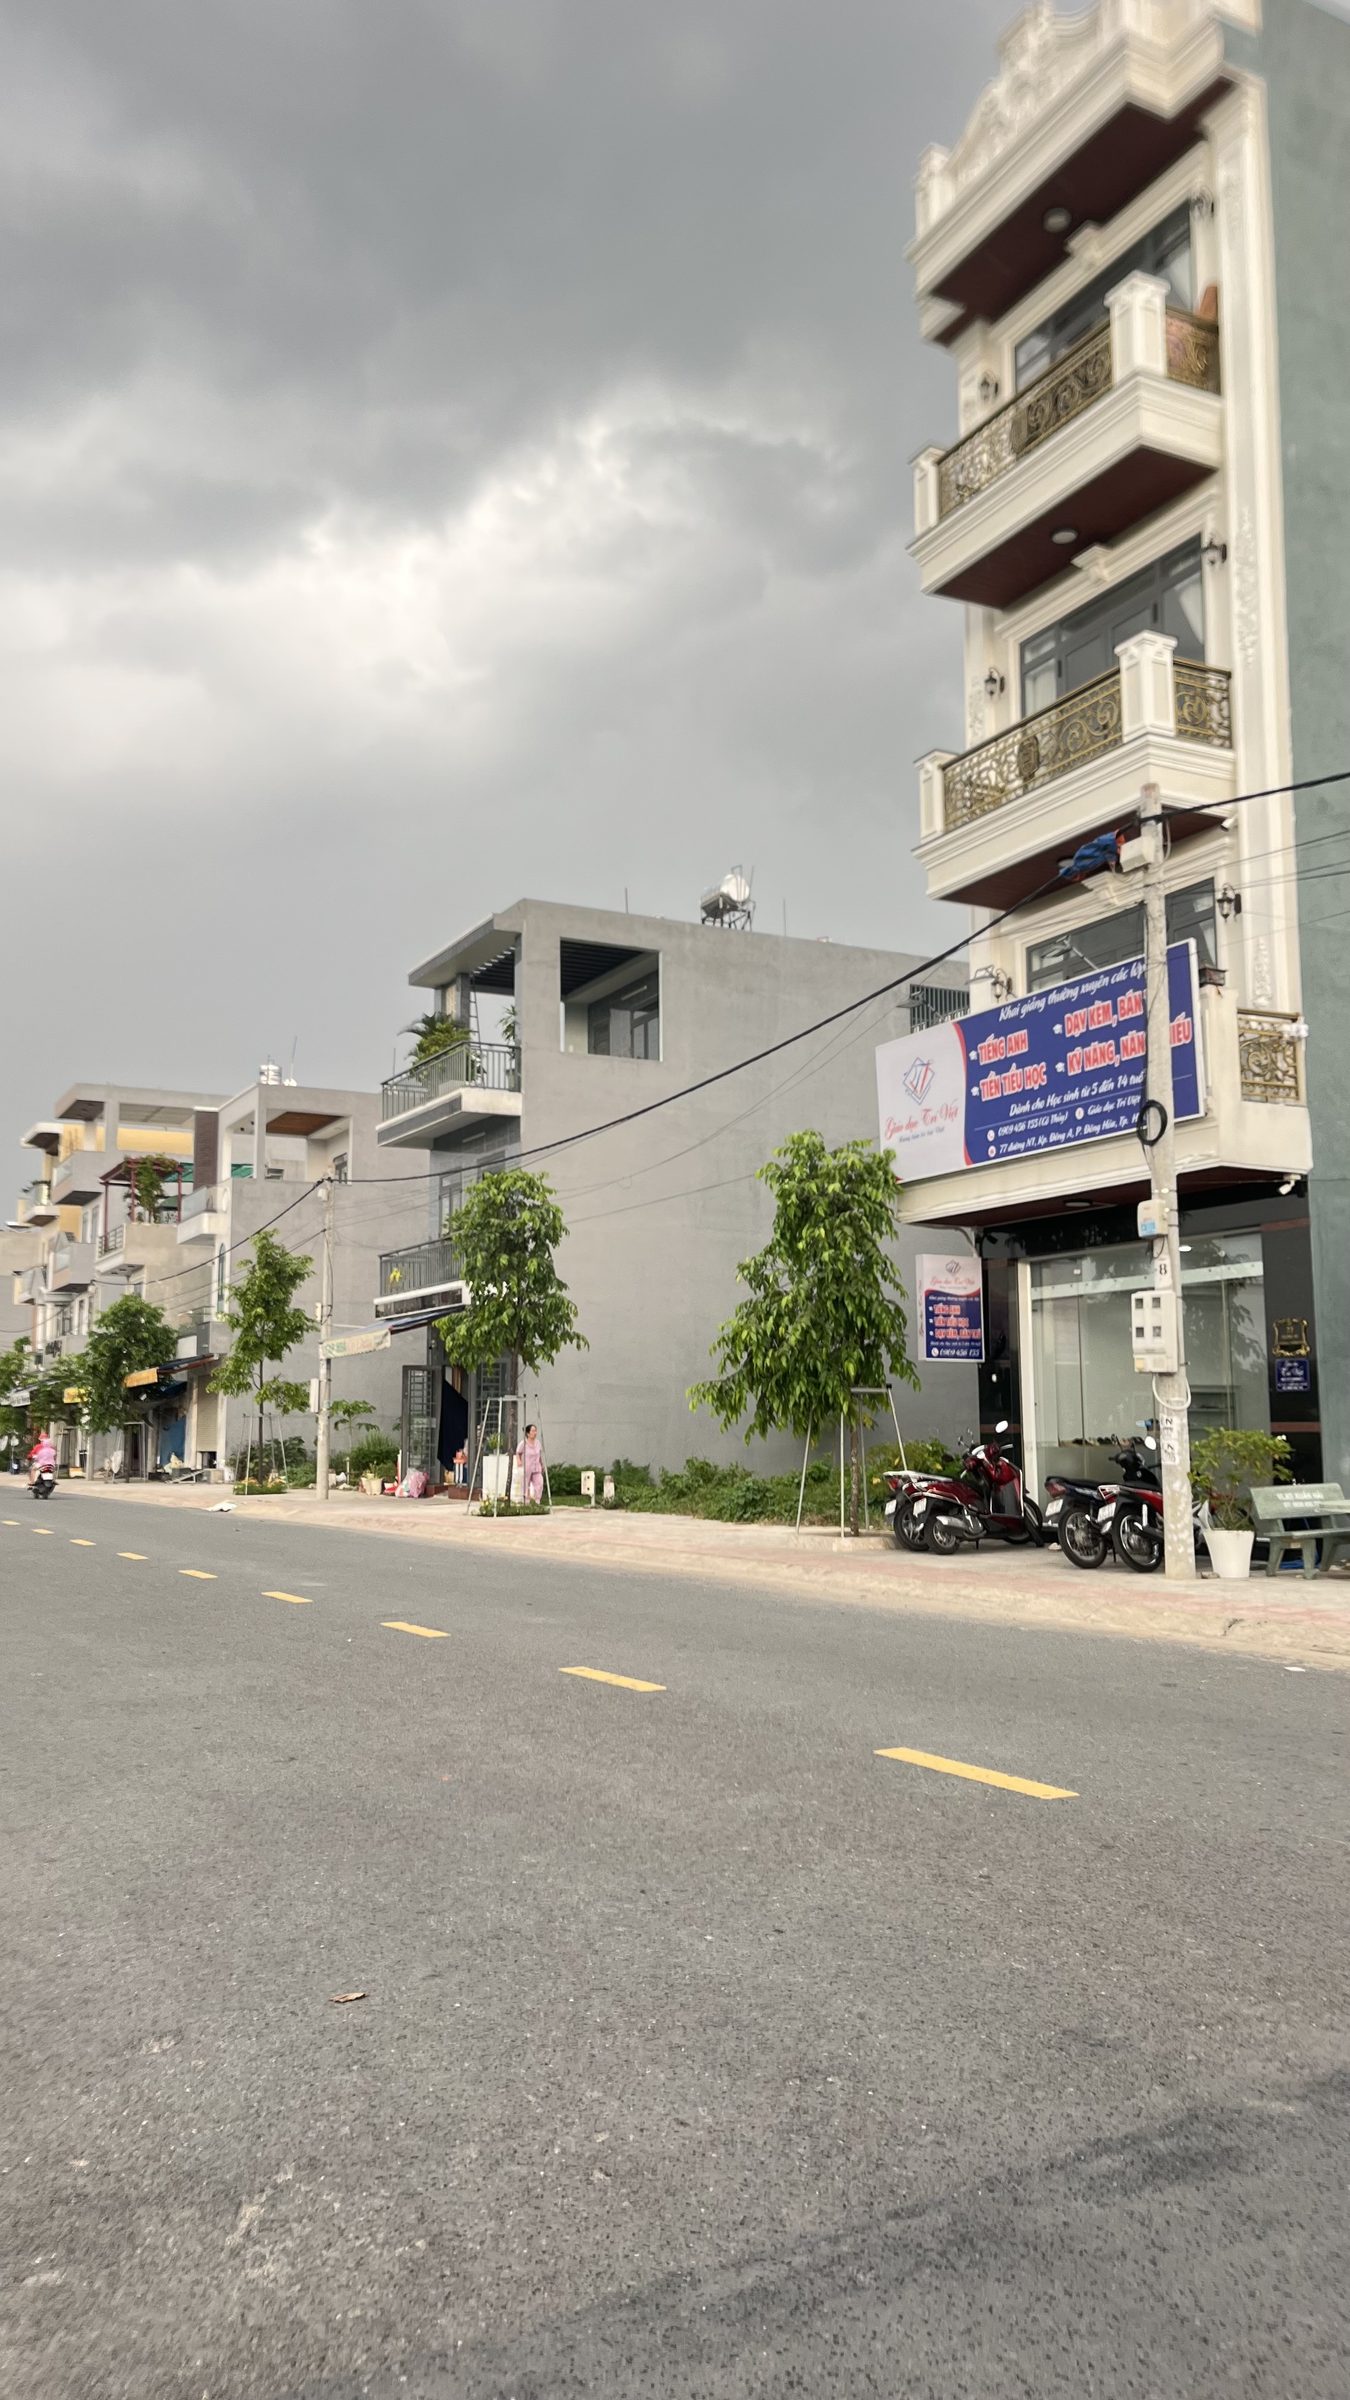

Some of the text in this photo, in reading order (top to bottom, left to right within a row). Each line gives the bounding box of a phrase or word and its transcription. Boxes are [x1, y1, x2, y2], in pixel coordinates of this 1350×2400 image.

[999, 1003, 1019, 1022] Khai
[1111, 967, 1129, 984] các
[1065, 1008, 1088, 1038] DẠY
[977, 1029, 1028, 1066] TIẾNG ANH
[1024, 1062, 1047, 1090] HỌC
[1031, 1097, 1045, 1111] cho
[1063, 1087, 1079, 1103] sinh
[1091, 1081, 1098, 1095] 5
[1117, 1074, 1128, 1089] 14
